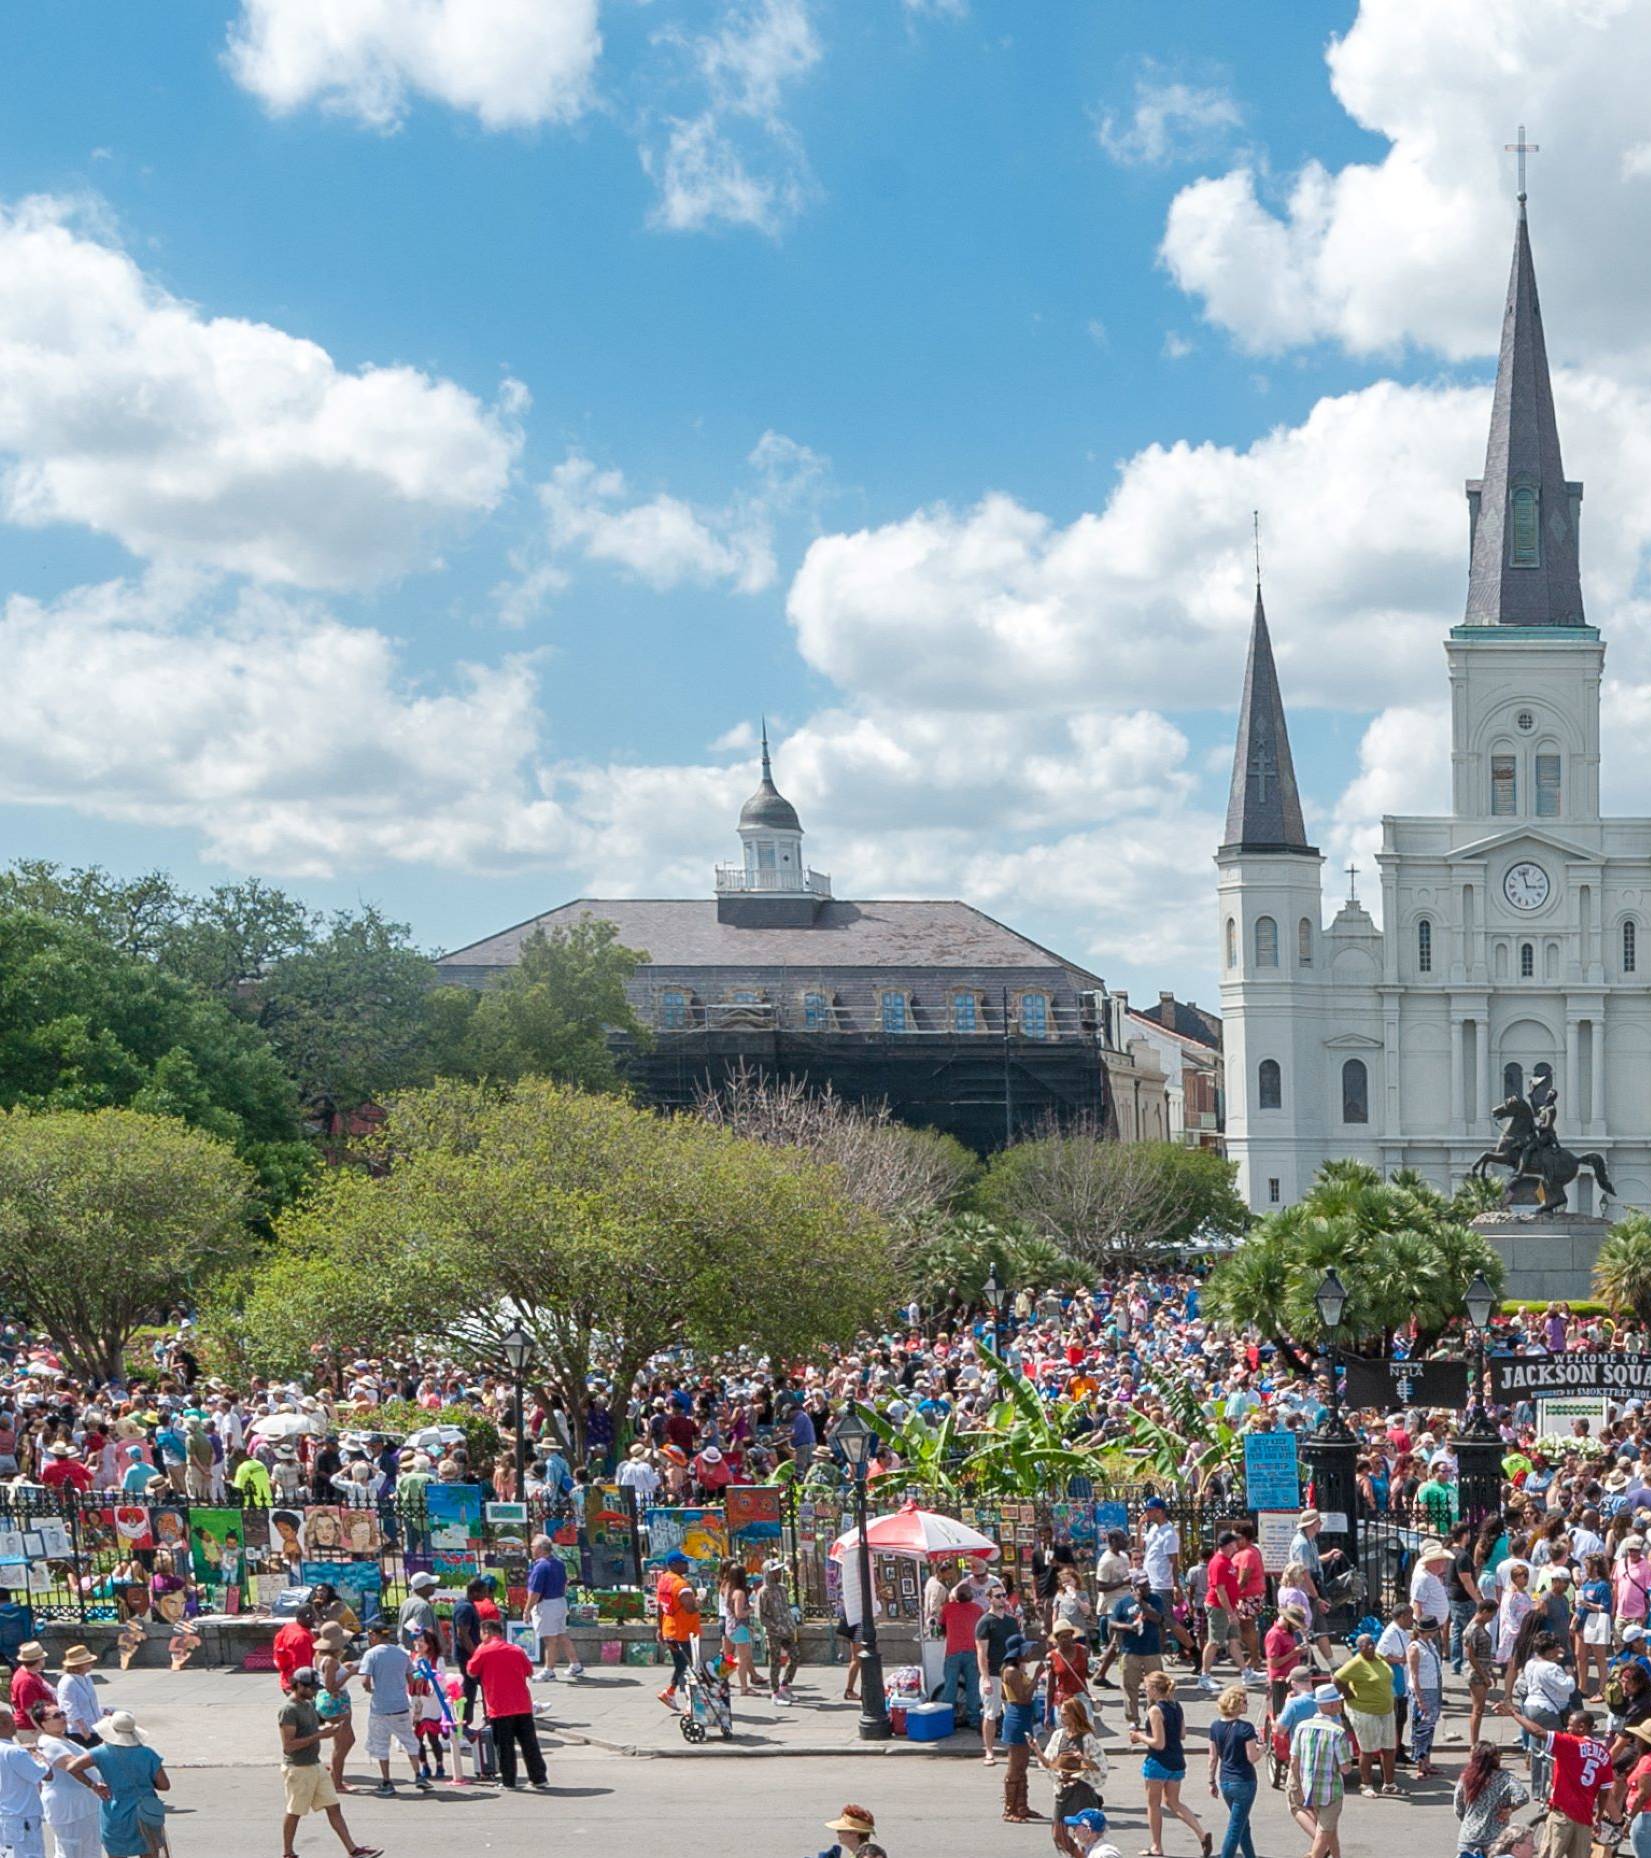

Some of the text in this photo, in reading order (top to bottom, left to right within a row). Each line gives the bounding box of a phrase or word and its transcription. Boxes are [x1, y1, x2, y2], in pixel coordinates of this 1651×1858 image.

[1553, 1353, 1639, 1364] WELCOME TO
[1501, 1364, 1598, 1389] JACKSON
[1581, 1758, 1600, 1786] 5
